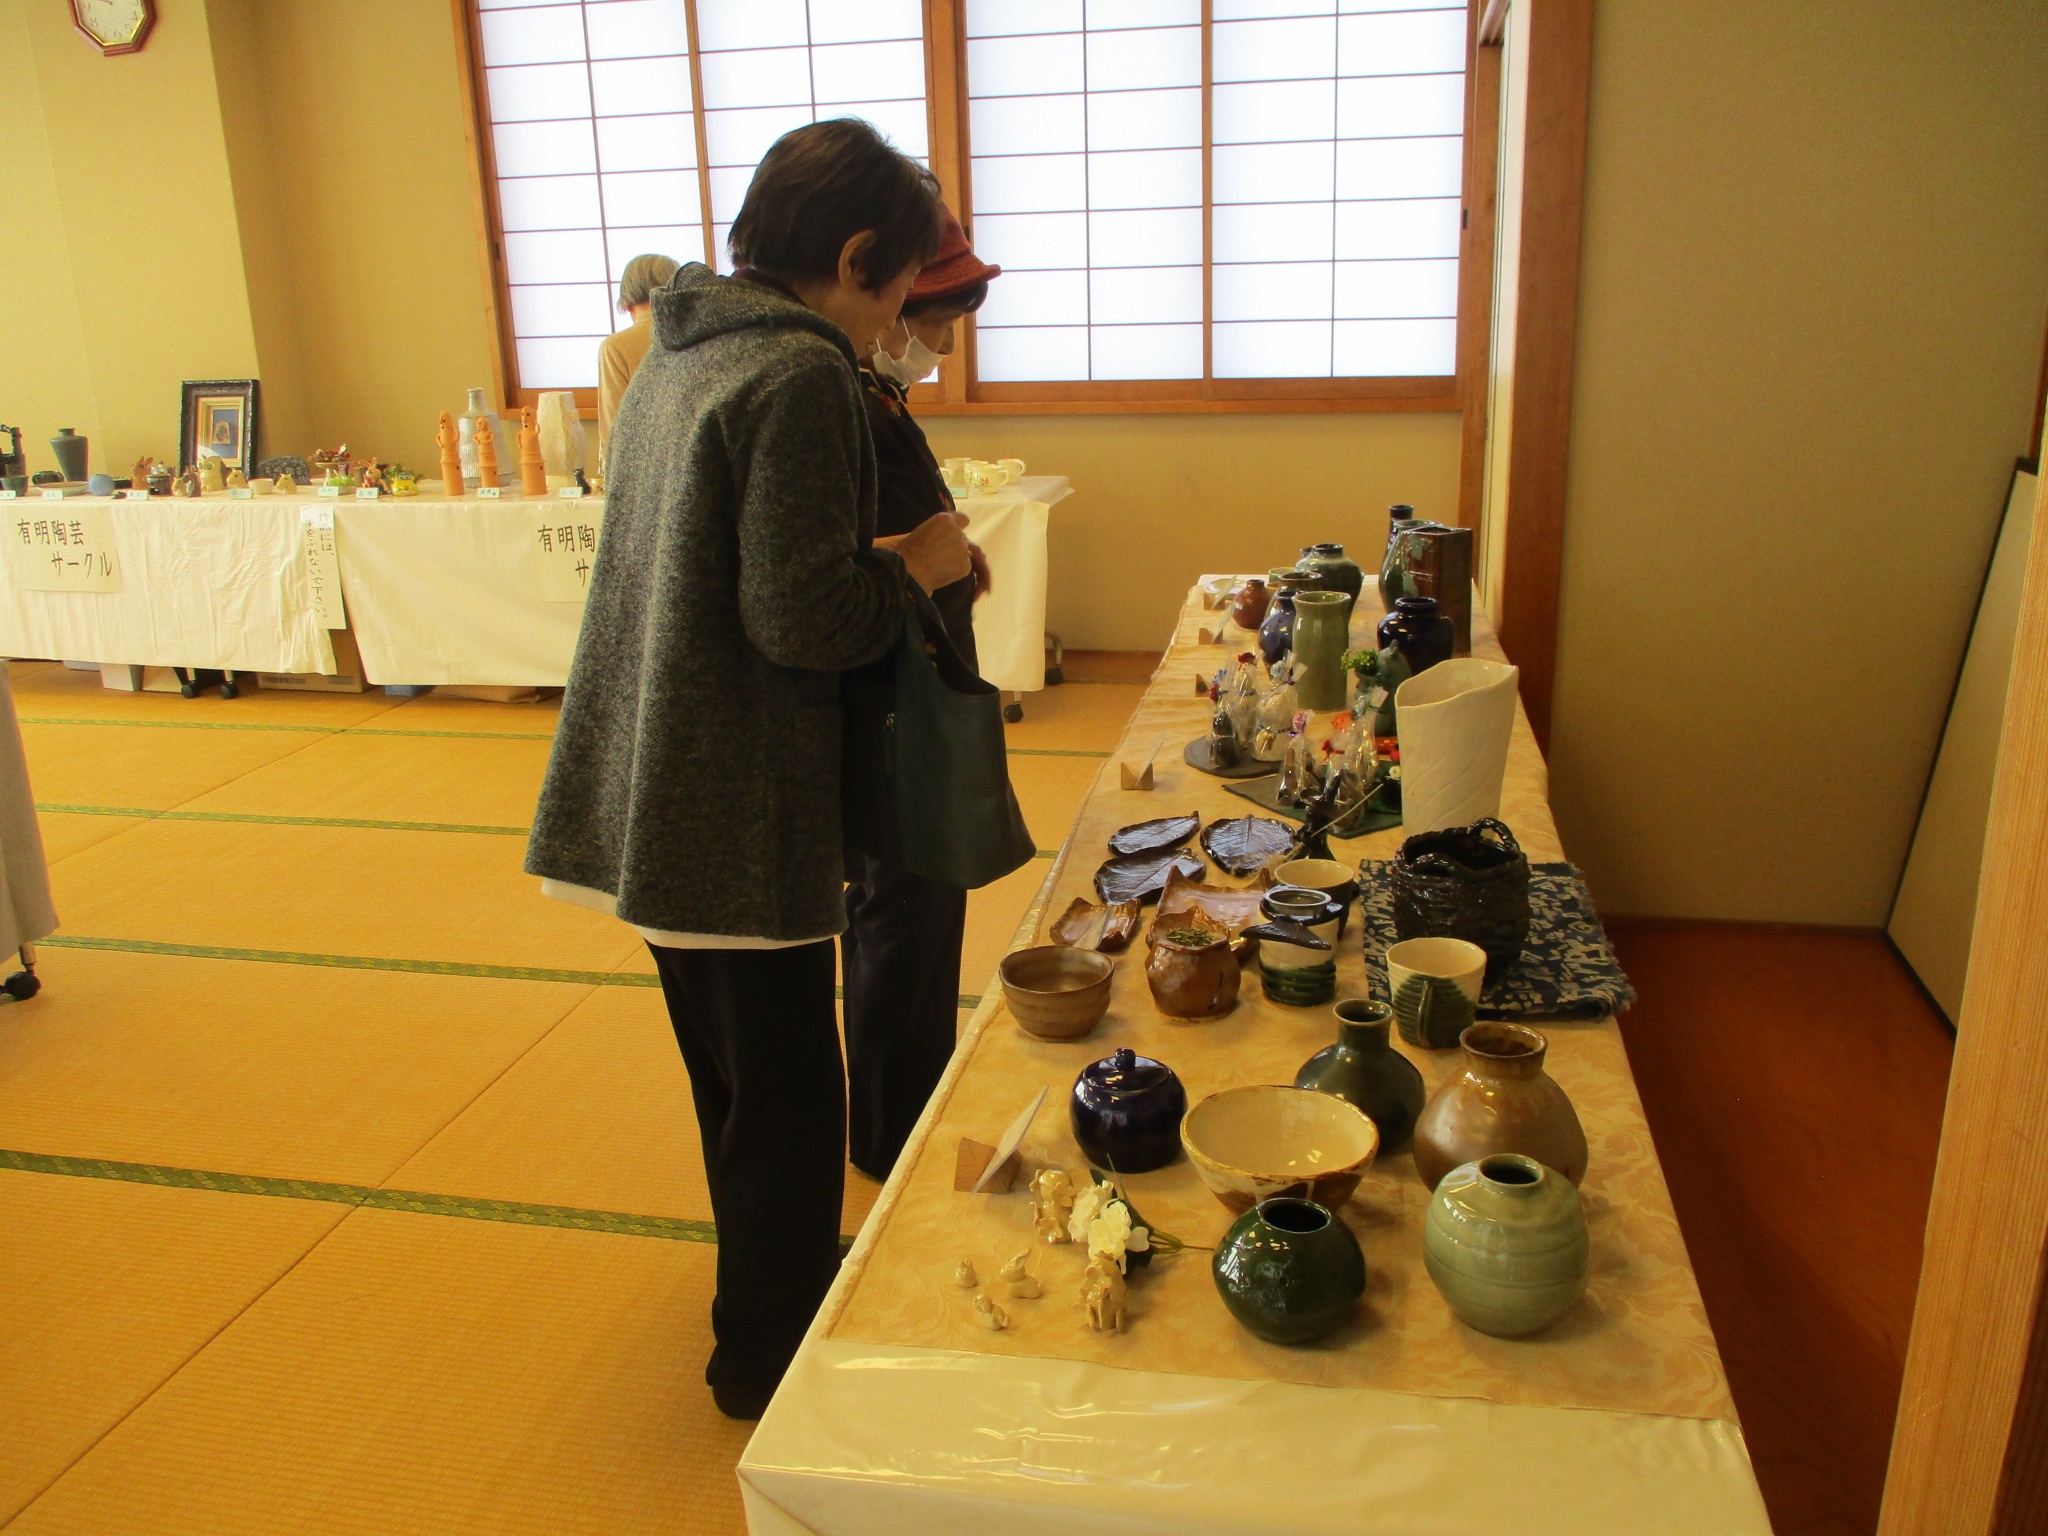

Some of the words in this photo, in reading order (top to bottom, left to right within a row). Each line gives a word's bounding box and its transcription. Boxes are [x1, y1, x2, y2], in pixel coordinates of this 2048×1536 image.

[17, 518, 85, 546] 有明陶芸
[537, 523, 602, 553] 有明陶
[51, 551, 113, 578] サークル
[575, 558, 590, 587] サ
